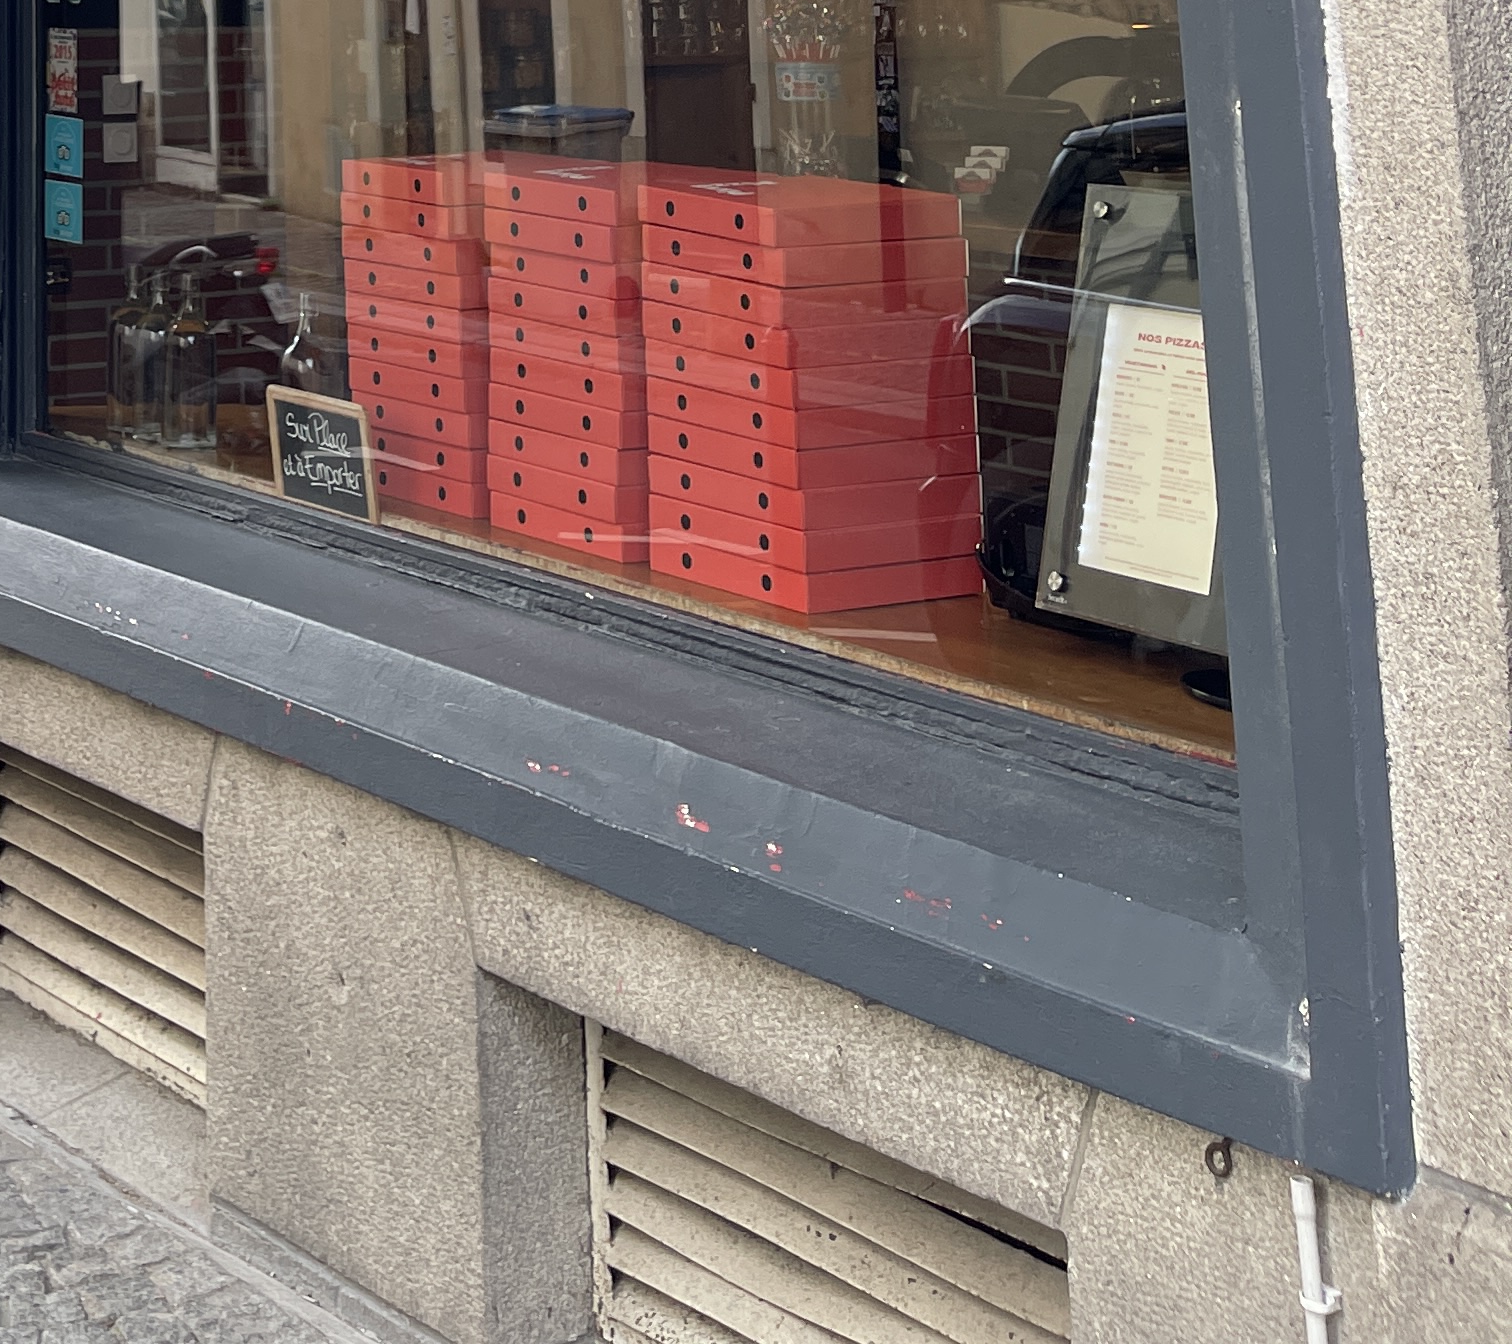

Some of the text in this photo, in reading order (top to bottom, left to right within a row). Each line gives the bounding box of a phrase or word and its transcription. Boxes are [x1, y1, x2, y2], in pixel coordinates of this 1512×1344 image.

[1137, 332, 1162, 344] NOS
[285, 412, 351, 455] Sur Place
[283, 454, 363, 495] et à Emporter
